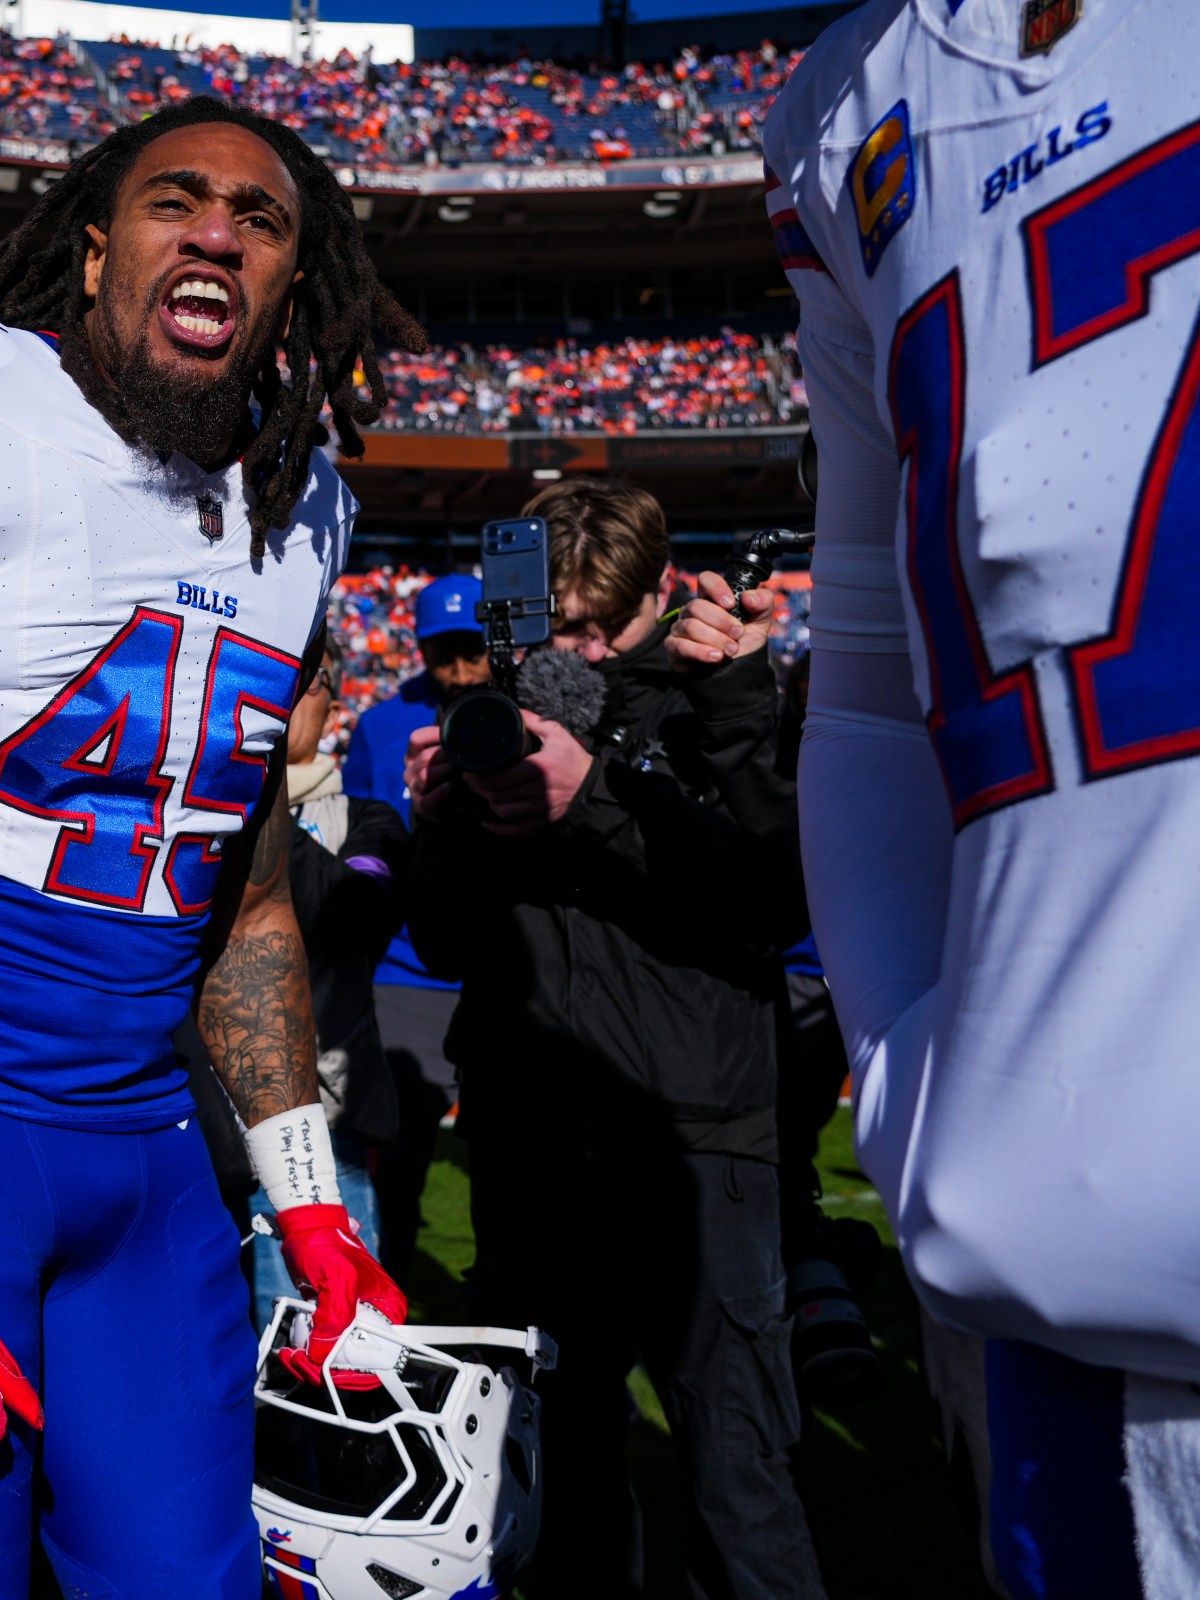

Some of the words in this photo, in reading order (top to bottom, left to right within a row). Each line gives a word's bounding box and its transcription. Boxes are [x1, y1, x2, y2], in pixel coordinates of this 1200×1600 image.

[853, 117, 907, 236] C
[981, 100, 1112, 214] BILLS
[506, 169, 520, 189] 7
[522, 168, 607, 188] MORTON
[886, 118, 1200, 835] 17
[202, 512, 223, 535] NFL
[176, 580, 238, 619] BILLS
[280, 1125, 294, 1154] Play
